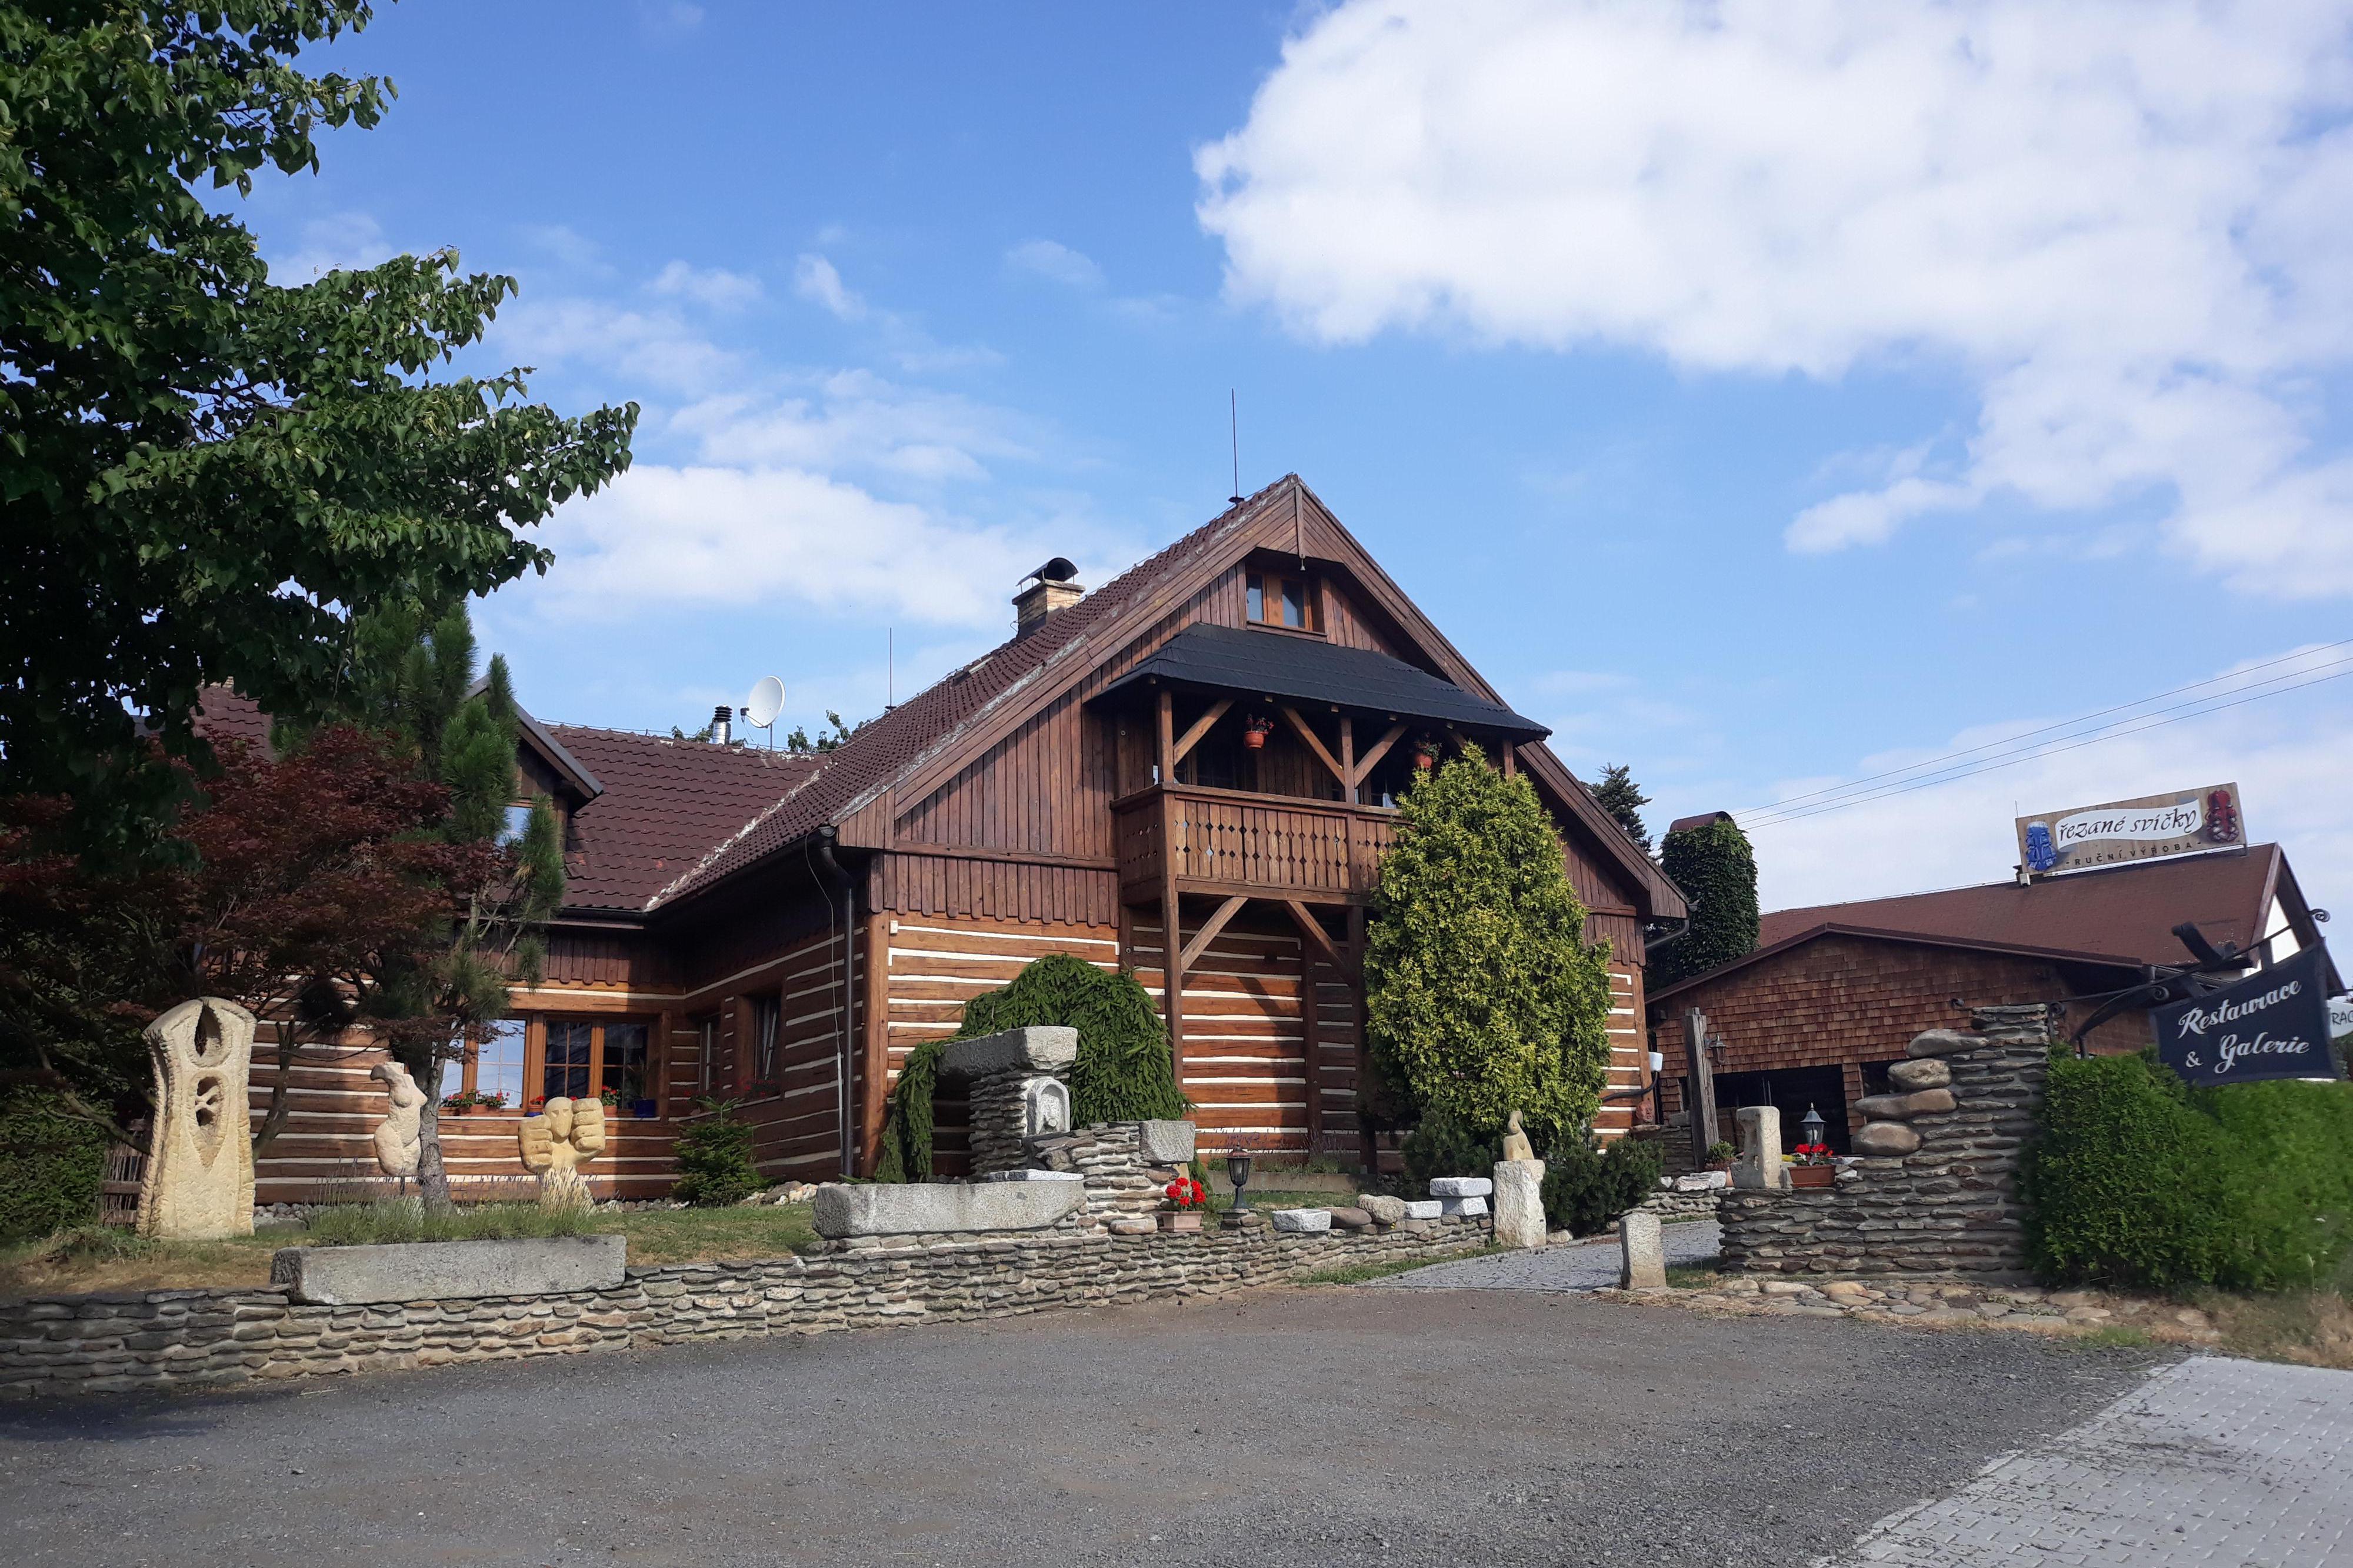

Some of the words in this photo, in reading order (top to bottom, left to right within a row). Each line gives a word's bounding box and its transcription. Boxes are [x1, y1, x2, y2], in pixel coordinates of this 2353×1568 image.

[2059, 816, 2126, 841] řezané
[2129, 808, 2196, 833] svíčky
[2178, 980, 2302, 1039] Restaurace
[2185, 1050, 2204, 1068] &
[2214, 1032, 2310, 1074] Galerie
